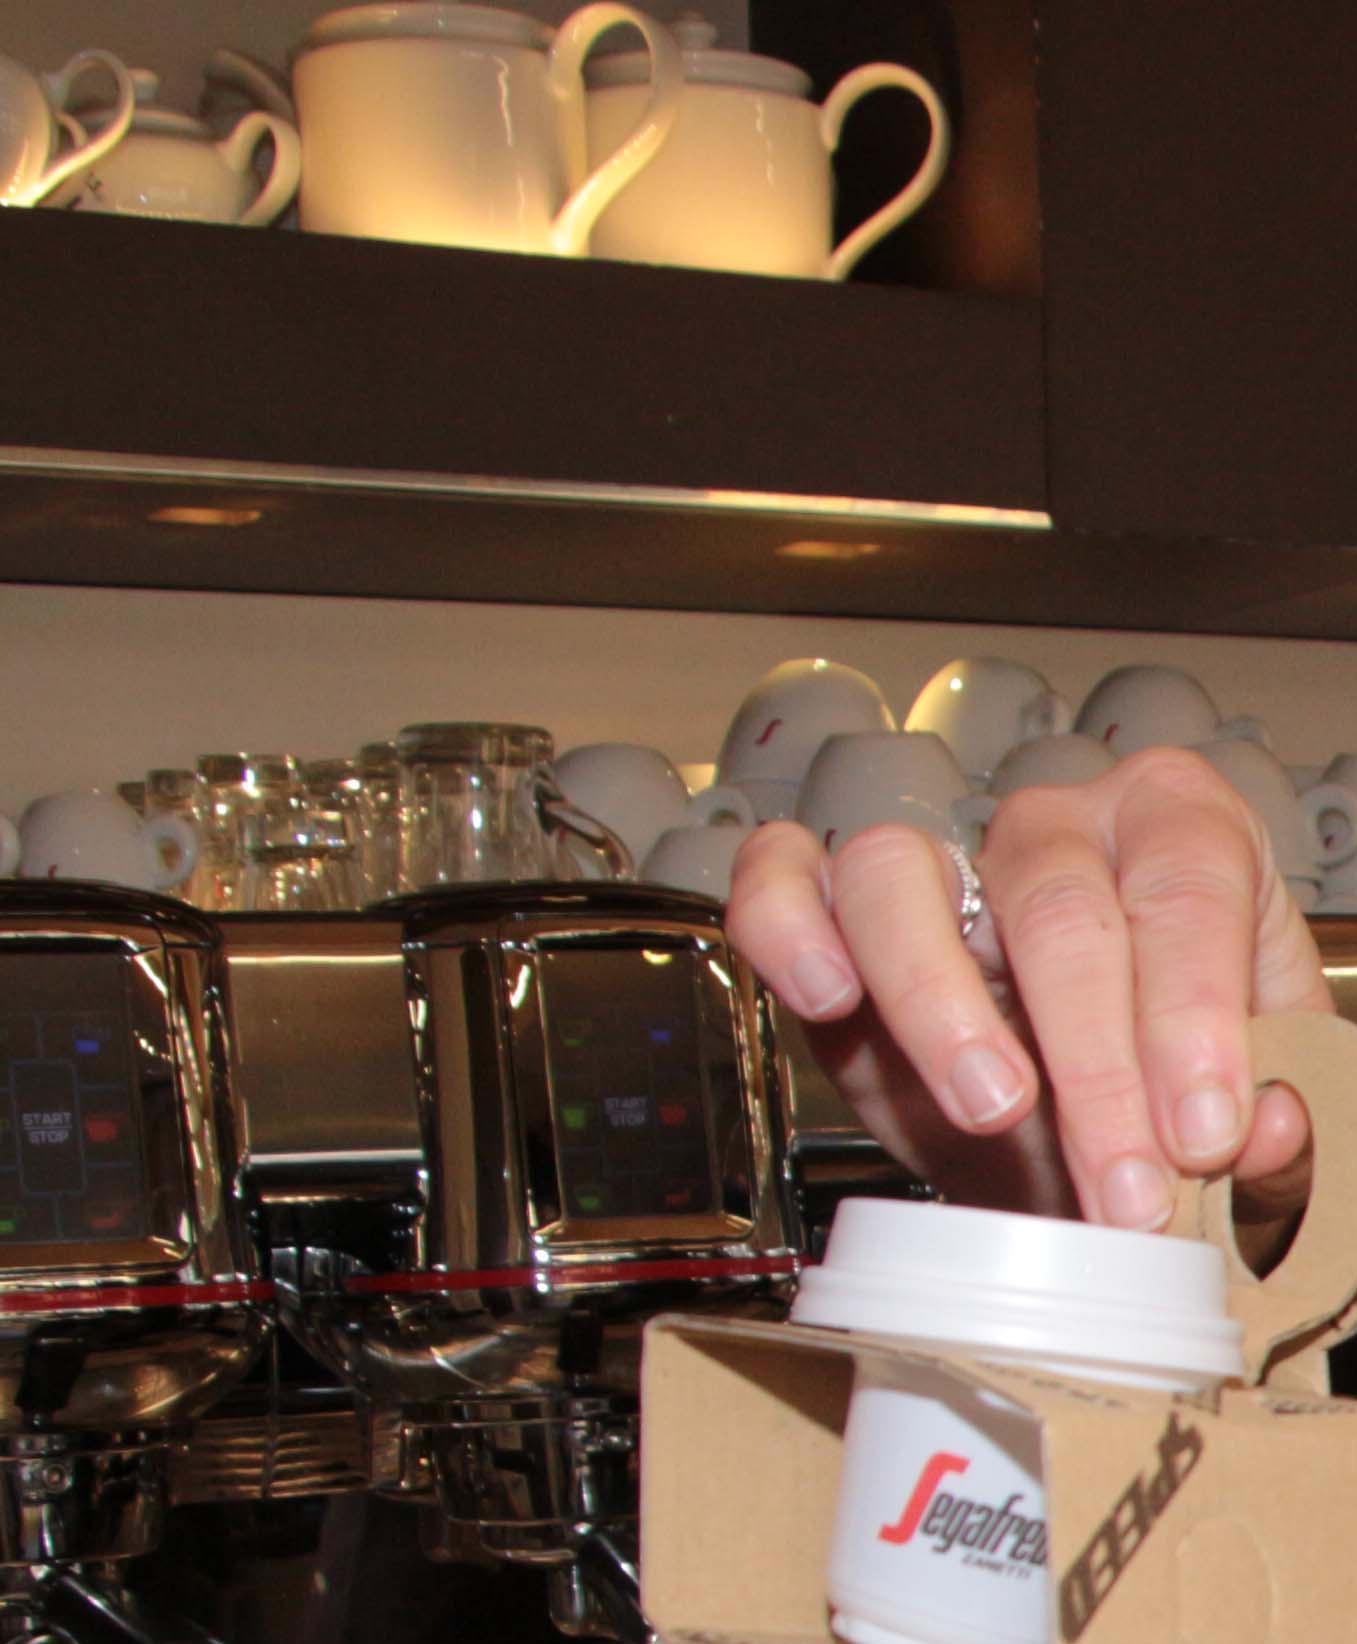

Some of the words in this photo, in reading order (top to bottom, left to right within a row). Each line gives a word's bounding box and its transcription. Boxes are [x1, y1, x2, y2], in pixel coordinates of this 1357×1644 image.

[22, 1111, 72, 1127] START
[610, 1111, 647, 1128] STOP
[28, 1129, 70, 1145] STOP
